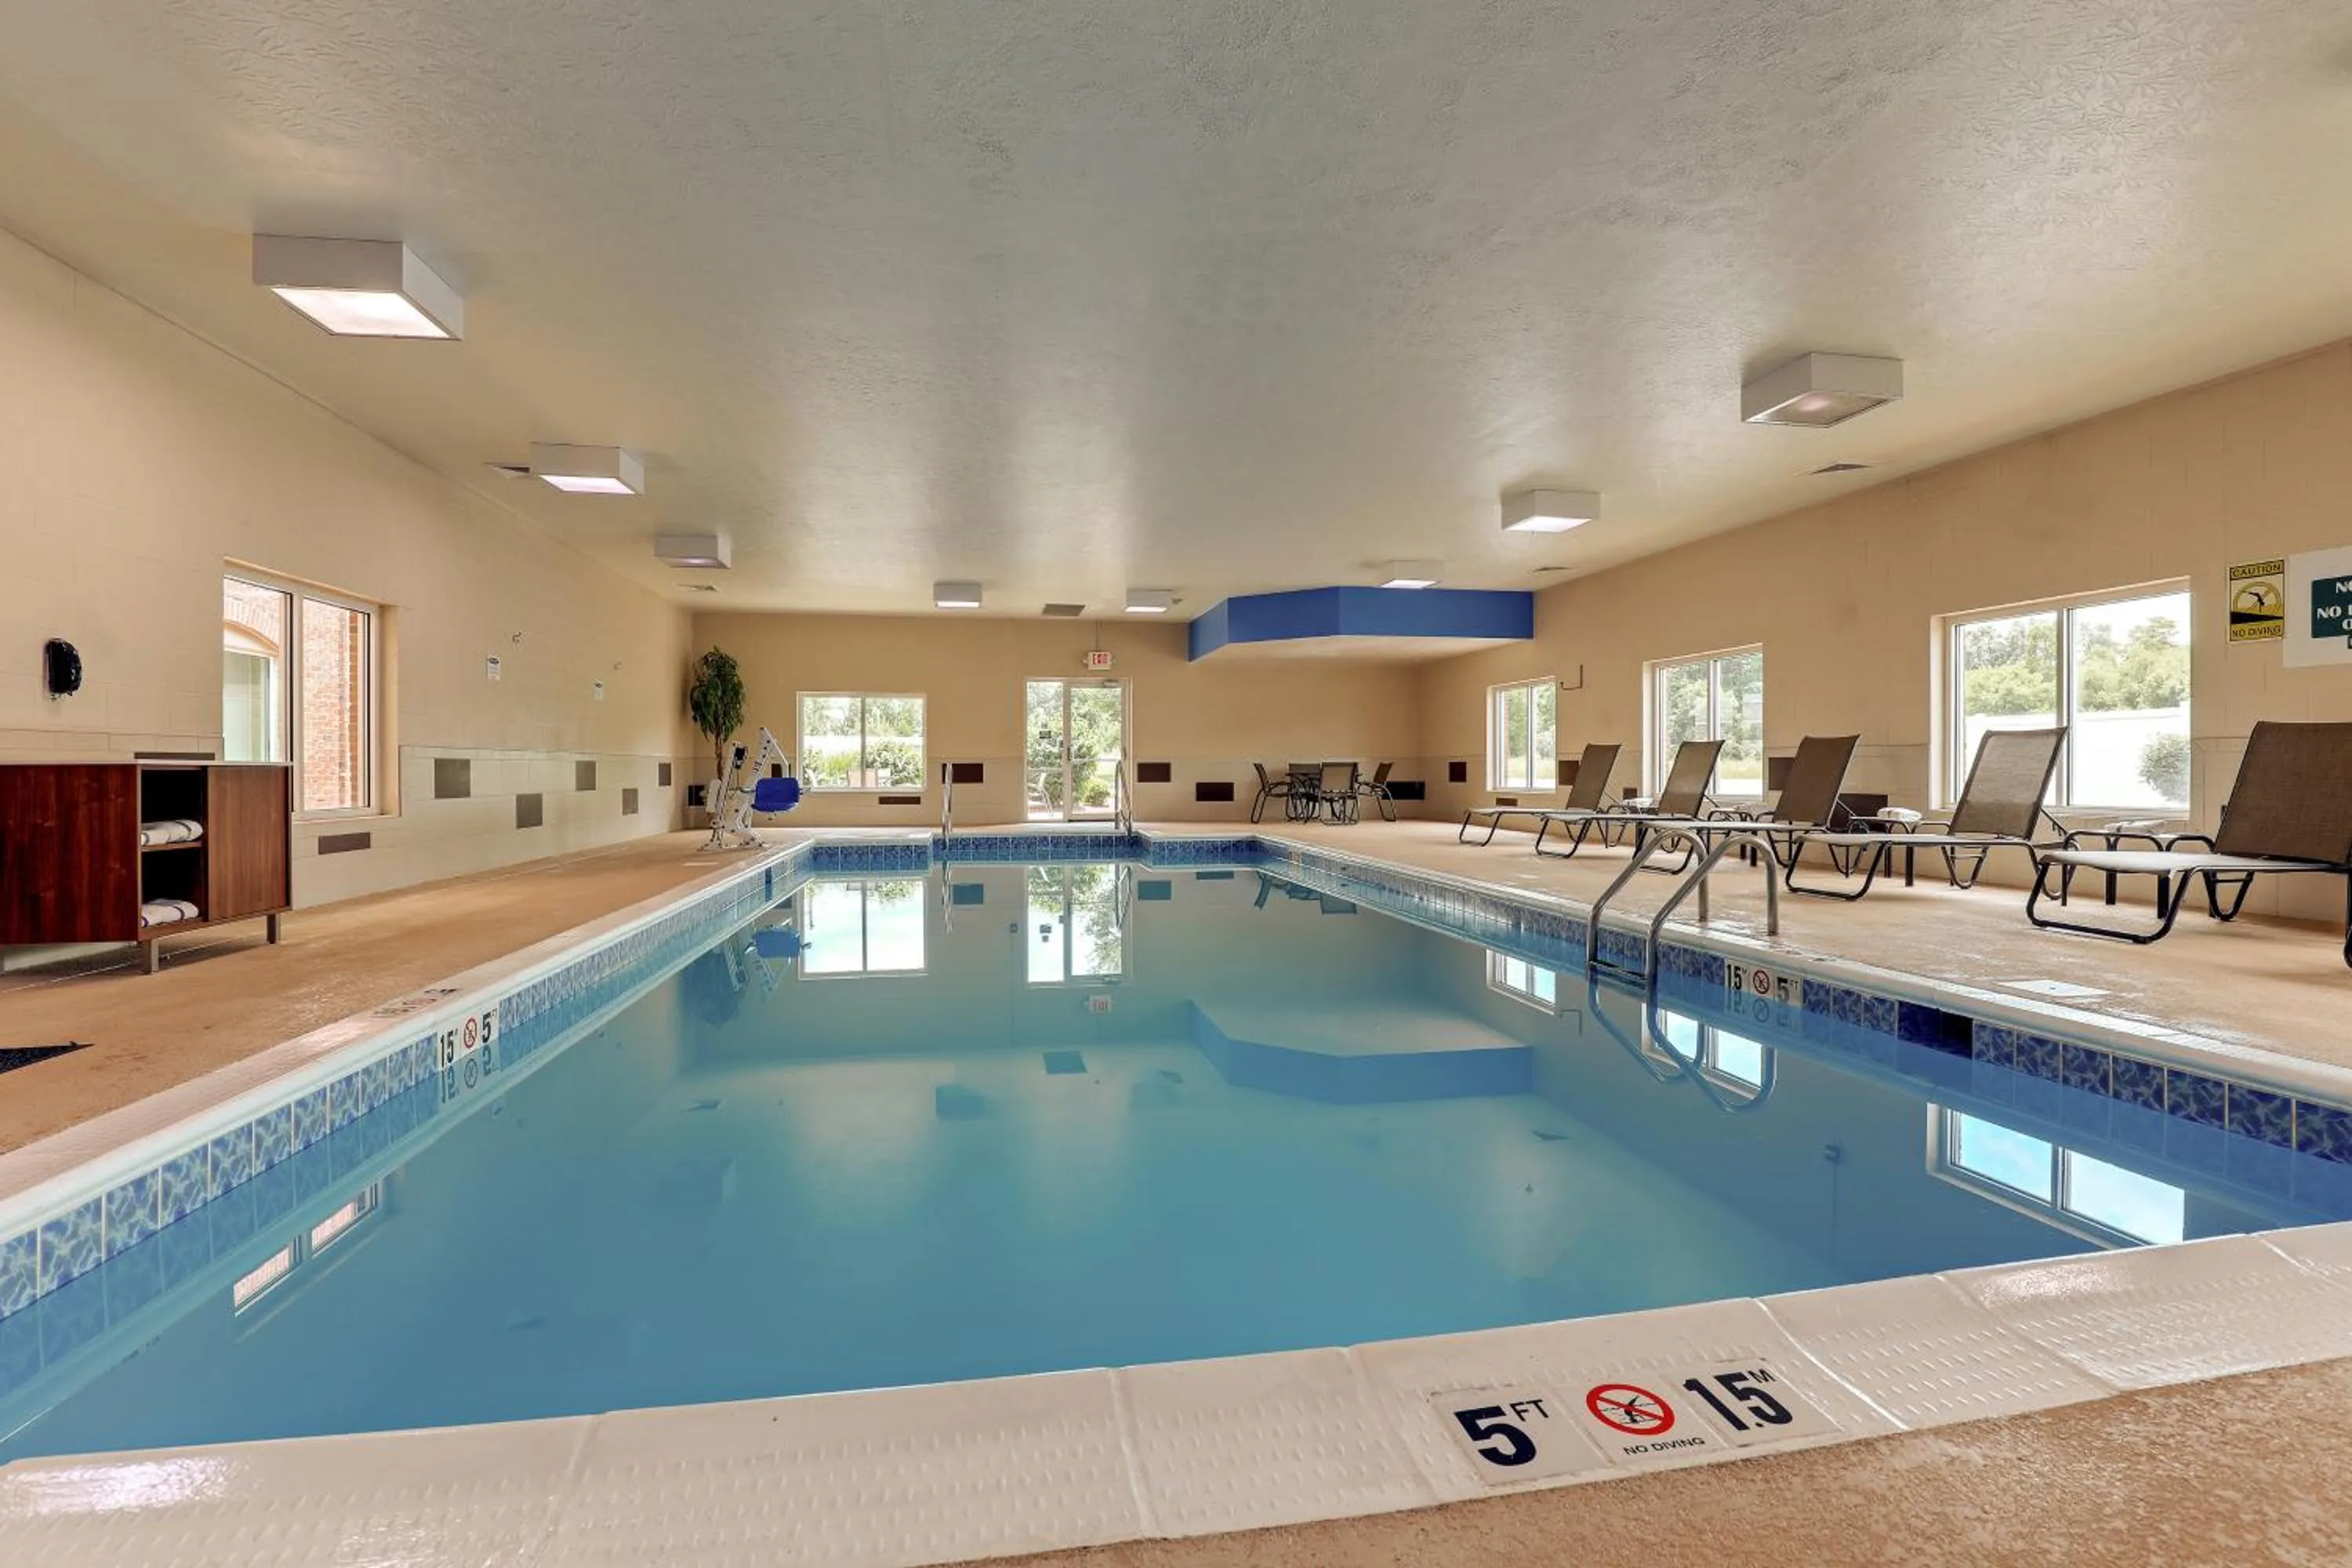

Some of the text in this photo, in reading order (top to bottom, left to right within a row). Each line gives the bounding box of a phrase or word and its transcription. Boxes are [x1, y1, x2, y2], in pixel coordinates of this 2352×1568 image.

[2232, 564, 2281, 578] CAUTION
[2317, 605, 2342, 620] NO
[2232, 625, 2281, 637] NO DIVING
[1622, 1436, 1706, 1456] NO DIVING
